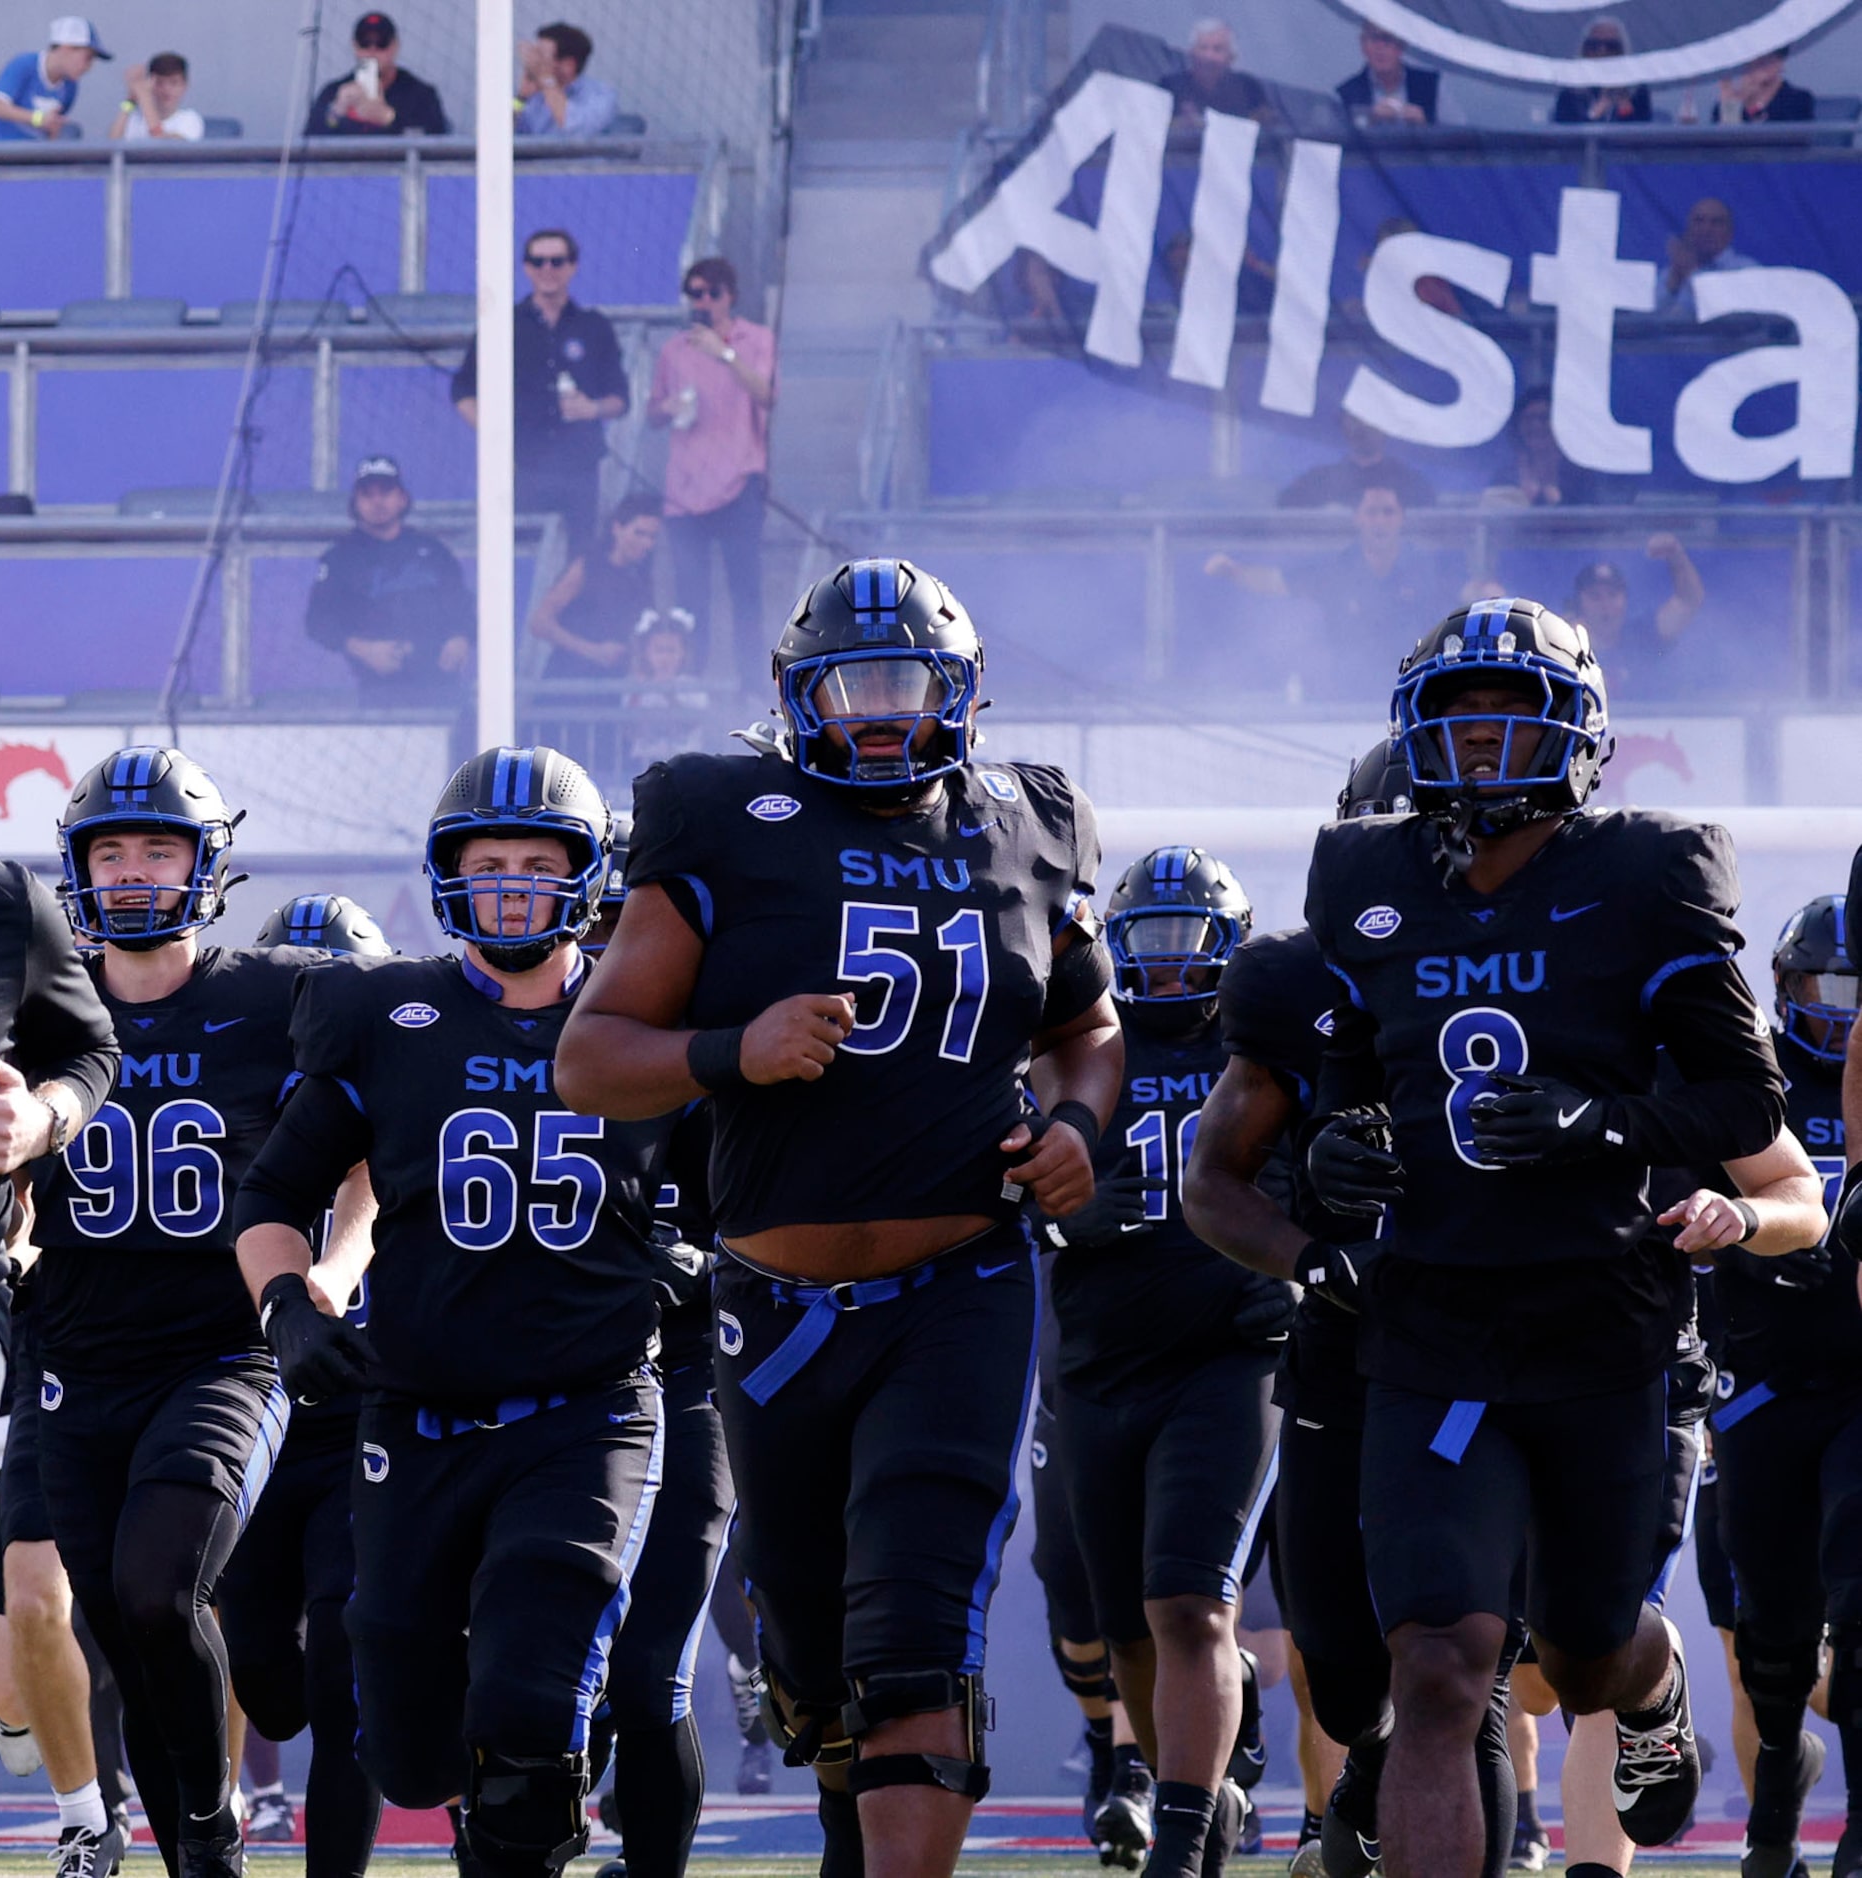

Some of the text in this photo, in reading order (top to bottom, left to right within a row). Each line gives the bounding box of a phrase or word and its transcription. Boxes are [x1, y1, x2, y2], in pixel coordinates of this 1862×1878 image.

[839, 849, 971, 893] SMU
[837, 900, 991, 1064] 51
[1415, 950, 1547, 998] SMU
[119, 1052, 202, 1088] MU
[465, 1055, 555, 1093] SM
[1438, 1006, 1529, 1170] 8
[63, 1098, 226, 1239] 96
[438, 1106, 606, 1252] 65
